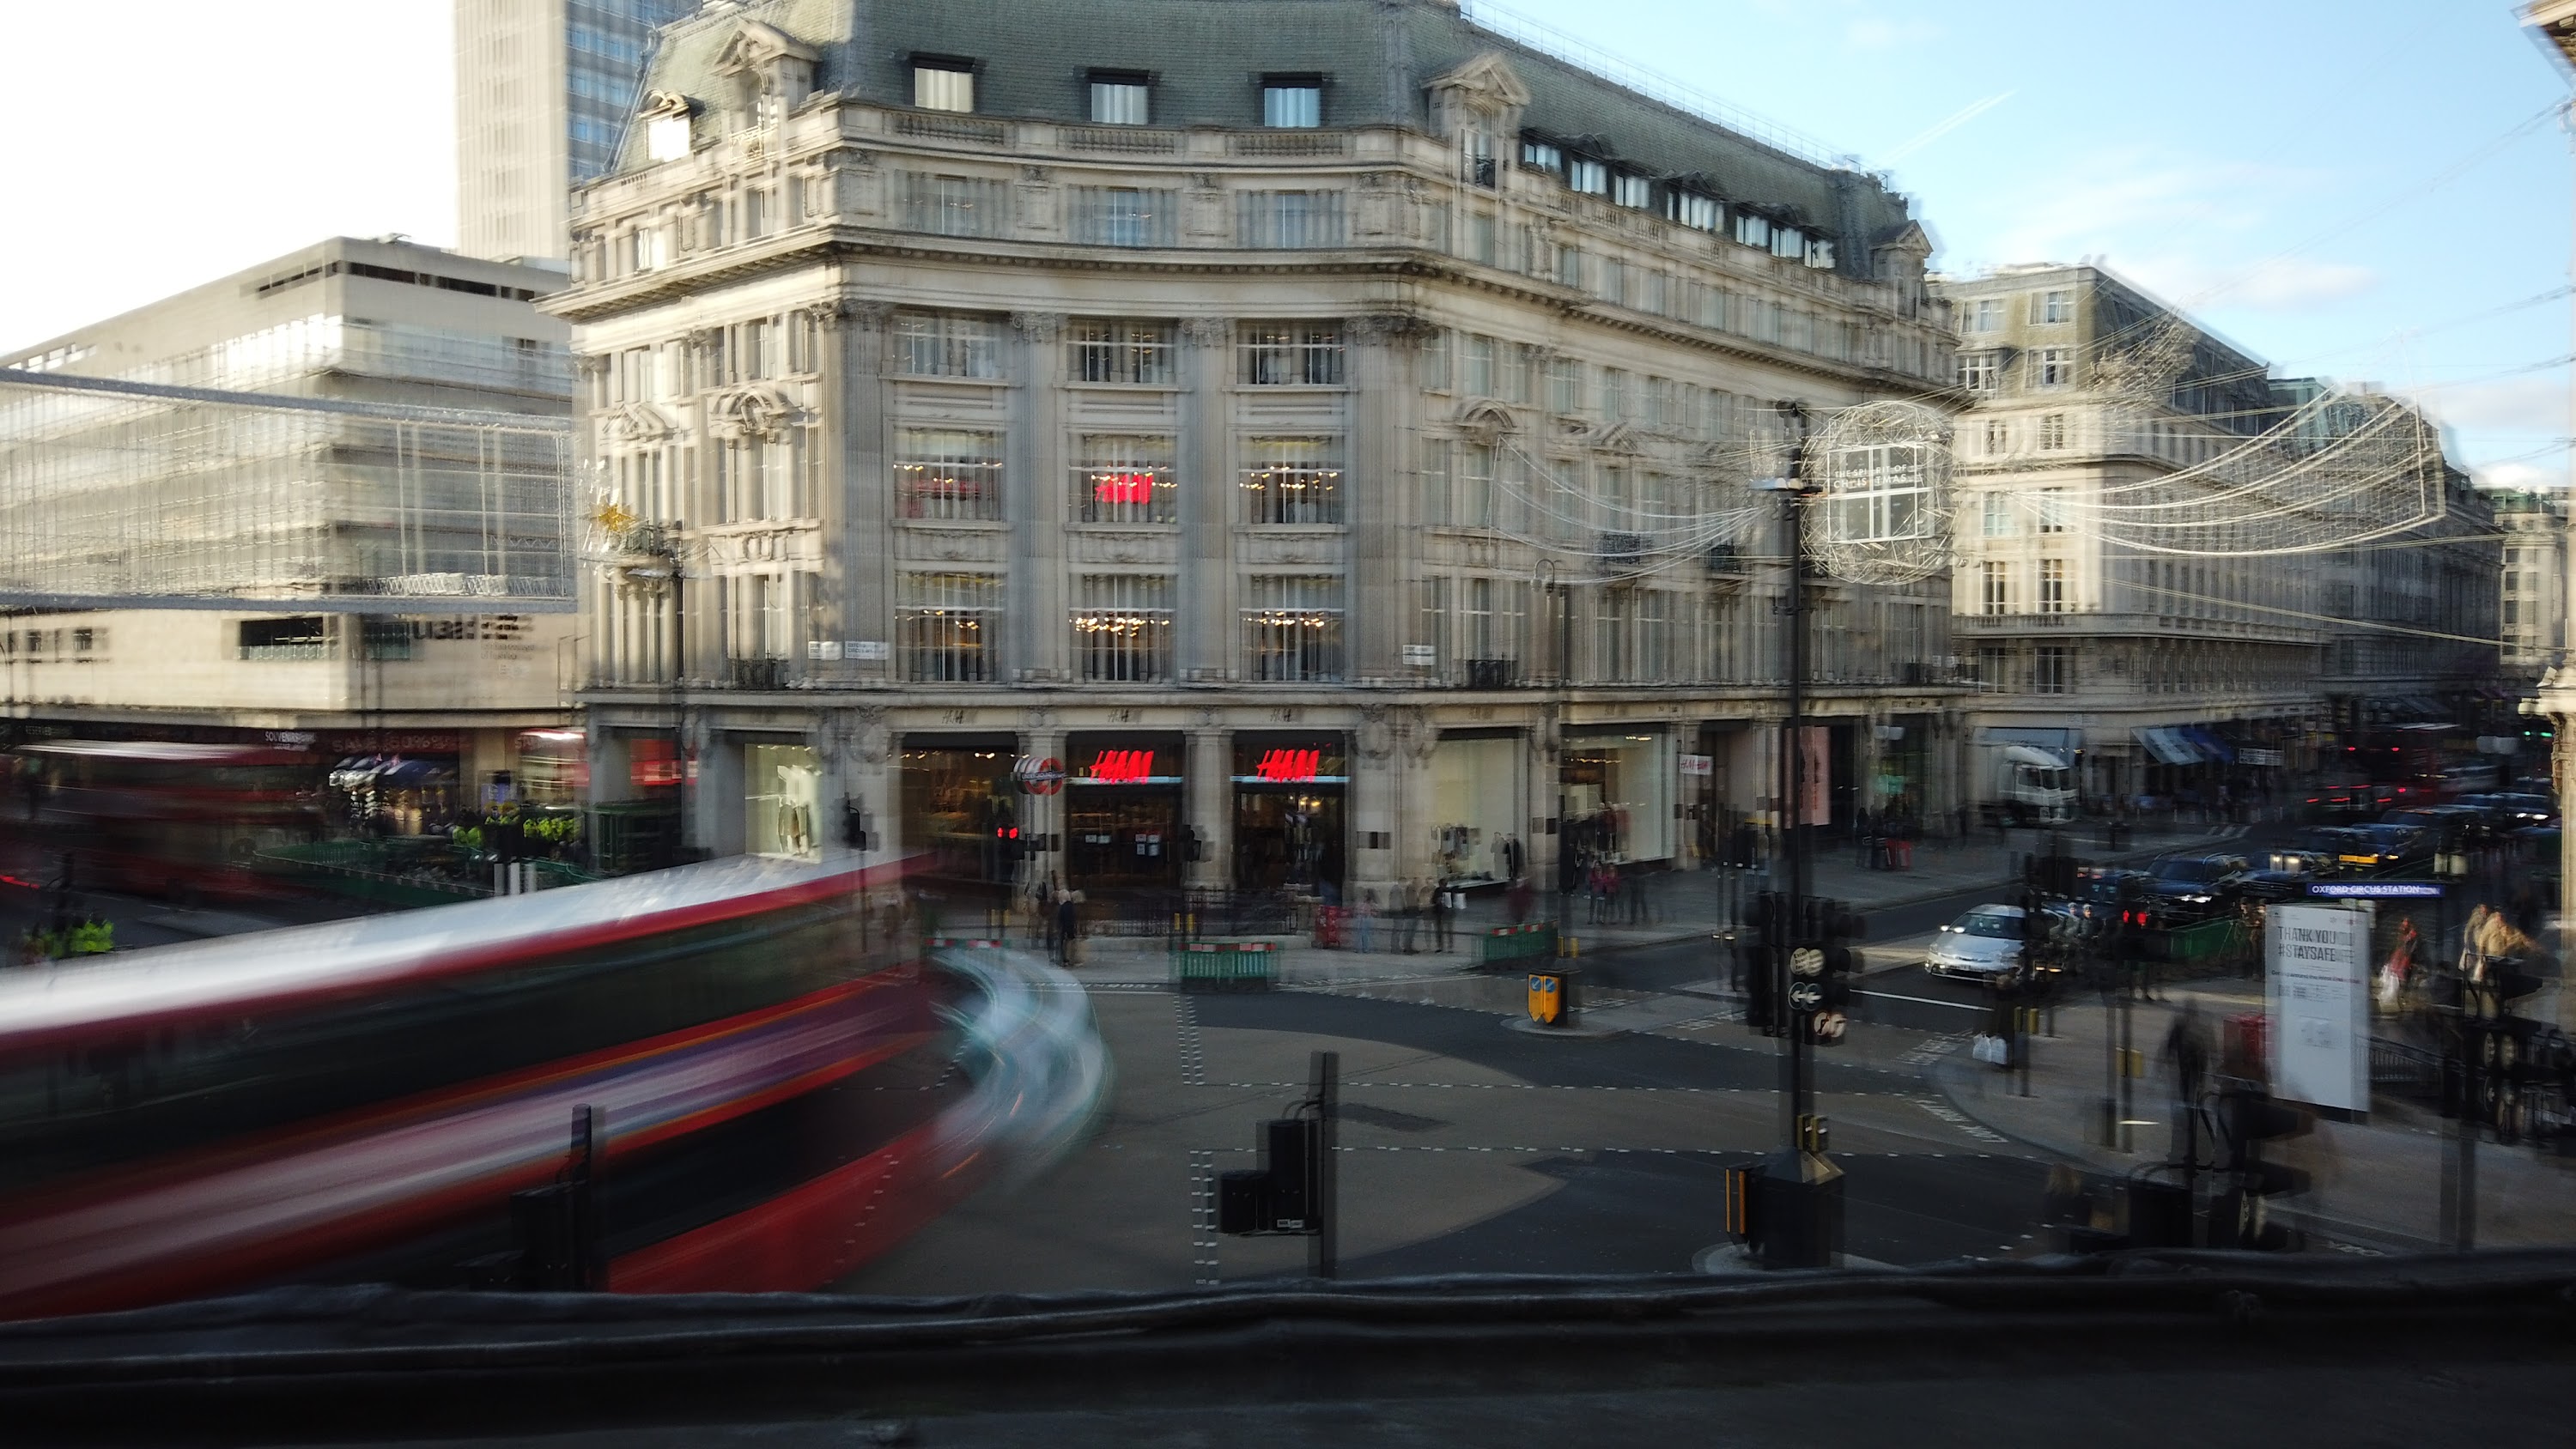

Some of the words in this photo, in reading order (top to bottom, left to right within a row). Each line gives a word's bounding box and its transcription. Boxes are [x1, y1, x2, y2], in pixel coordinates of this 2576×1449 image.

[1835, 470, 1851, 478] THE
[1854, 465, 1891, 476] SPIRIT
[1833, 473, 1907, 488] CHISTMAS
[2312, 885, 2348, 894] OXFORD
[2349, 885, 2380, 894] CIRCUS
[2383, 885, 2420, 894] STATION
[2278, 926, 2312, 943] THANK
[2315, 930, 2336, 944] YOU
[2278, 943, 2336, 962] #STAYSAFE
